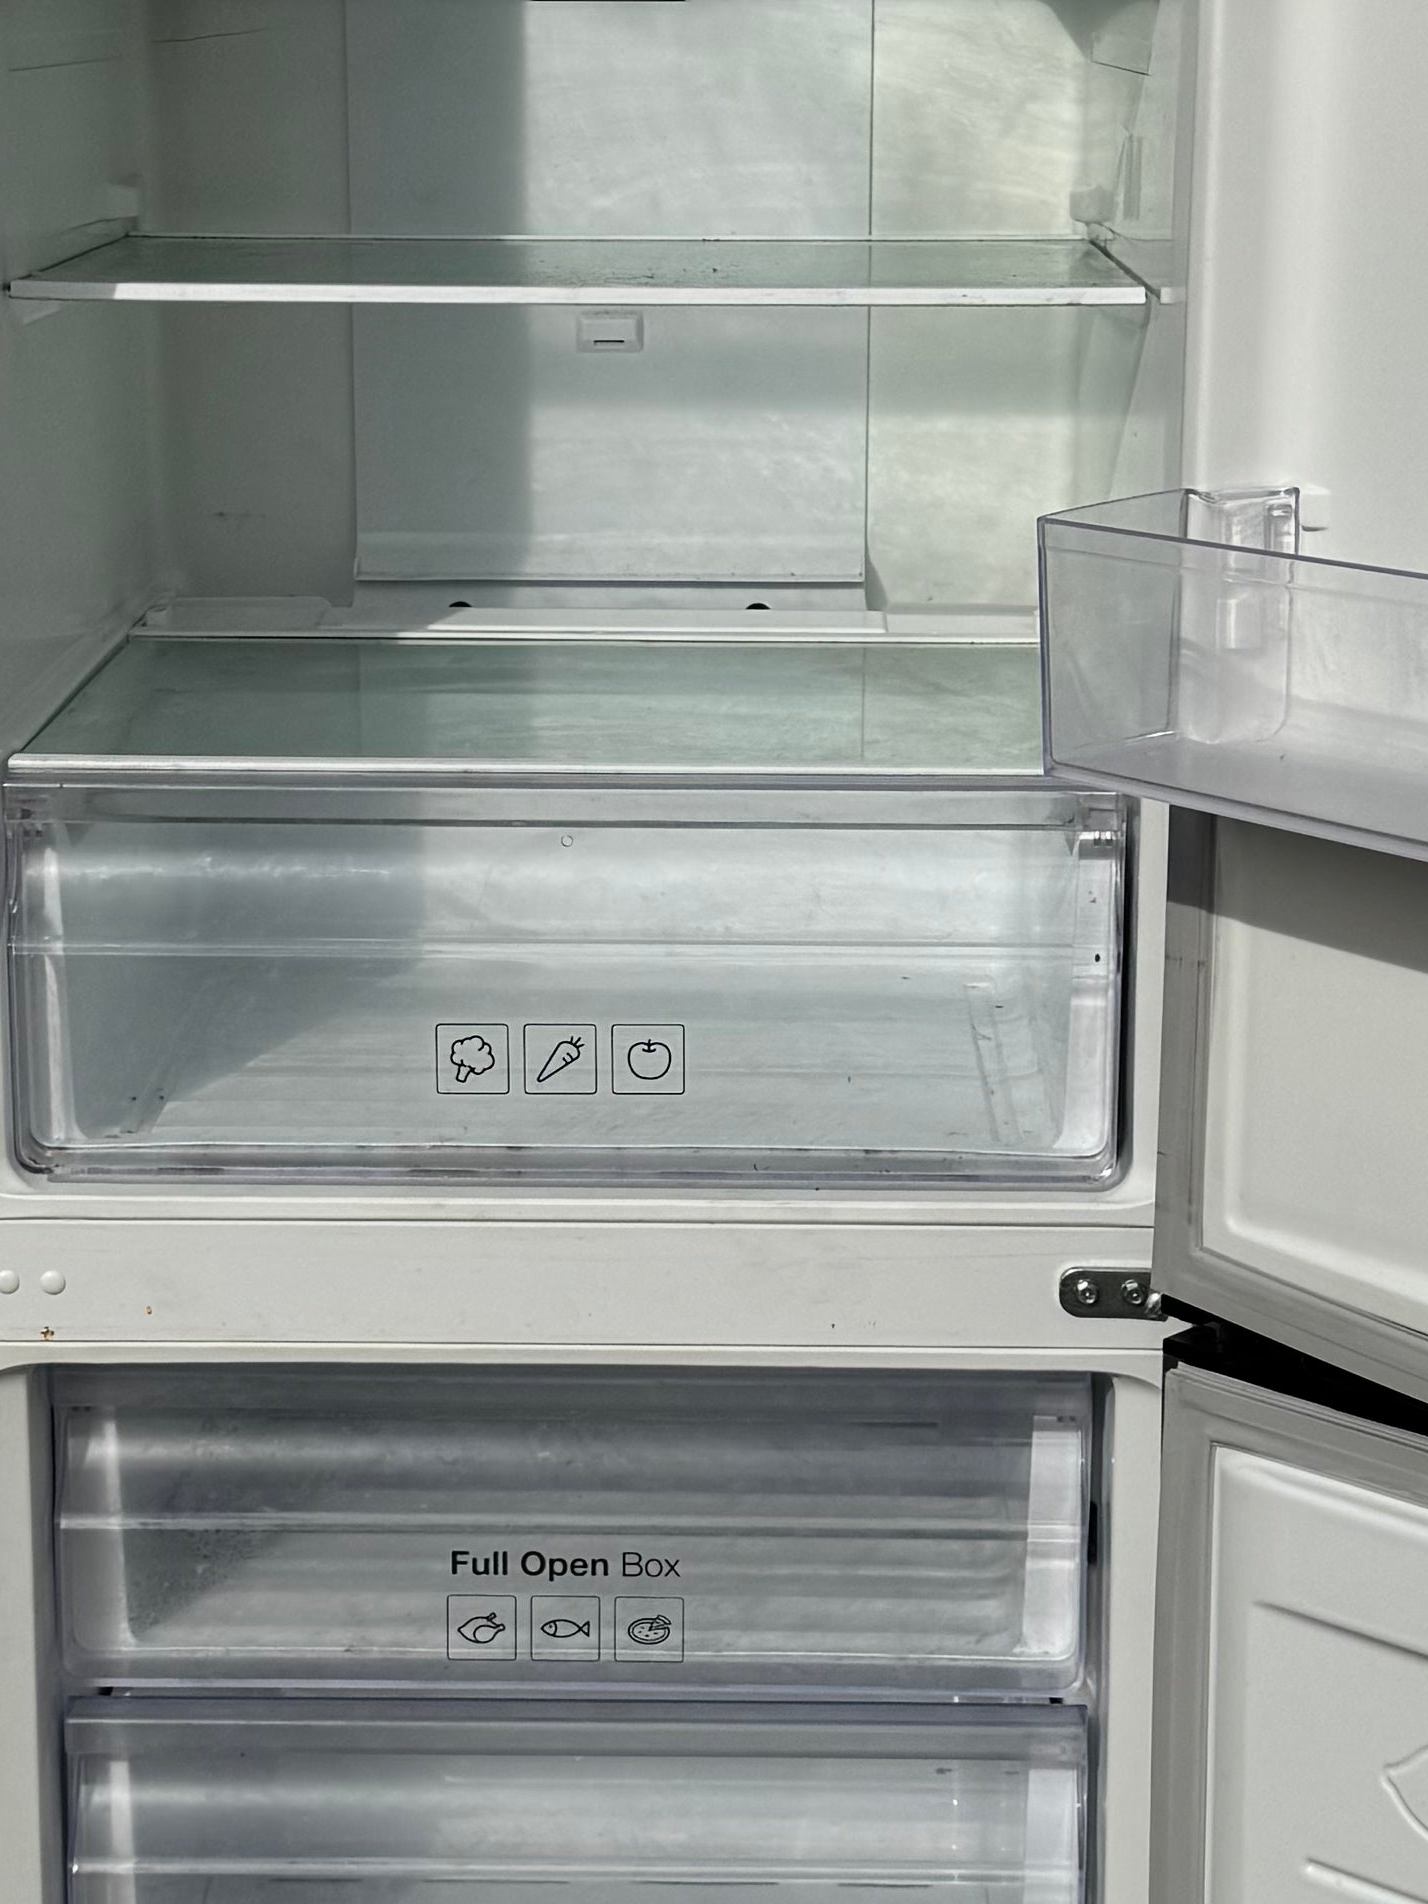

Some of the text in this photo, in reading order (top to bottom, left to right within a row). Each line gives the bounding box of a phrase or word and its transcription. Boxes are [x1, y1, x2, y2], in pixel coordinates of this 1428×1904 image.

[451, 1550, 681, 1582] Full Open Box
